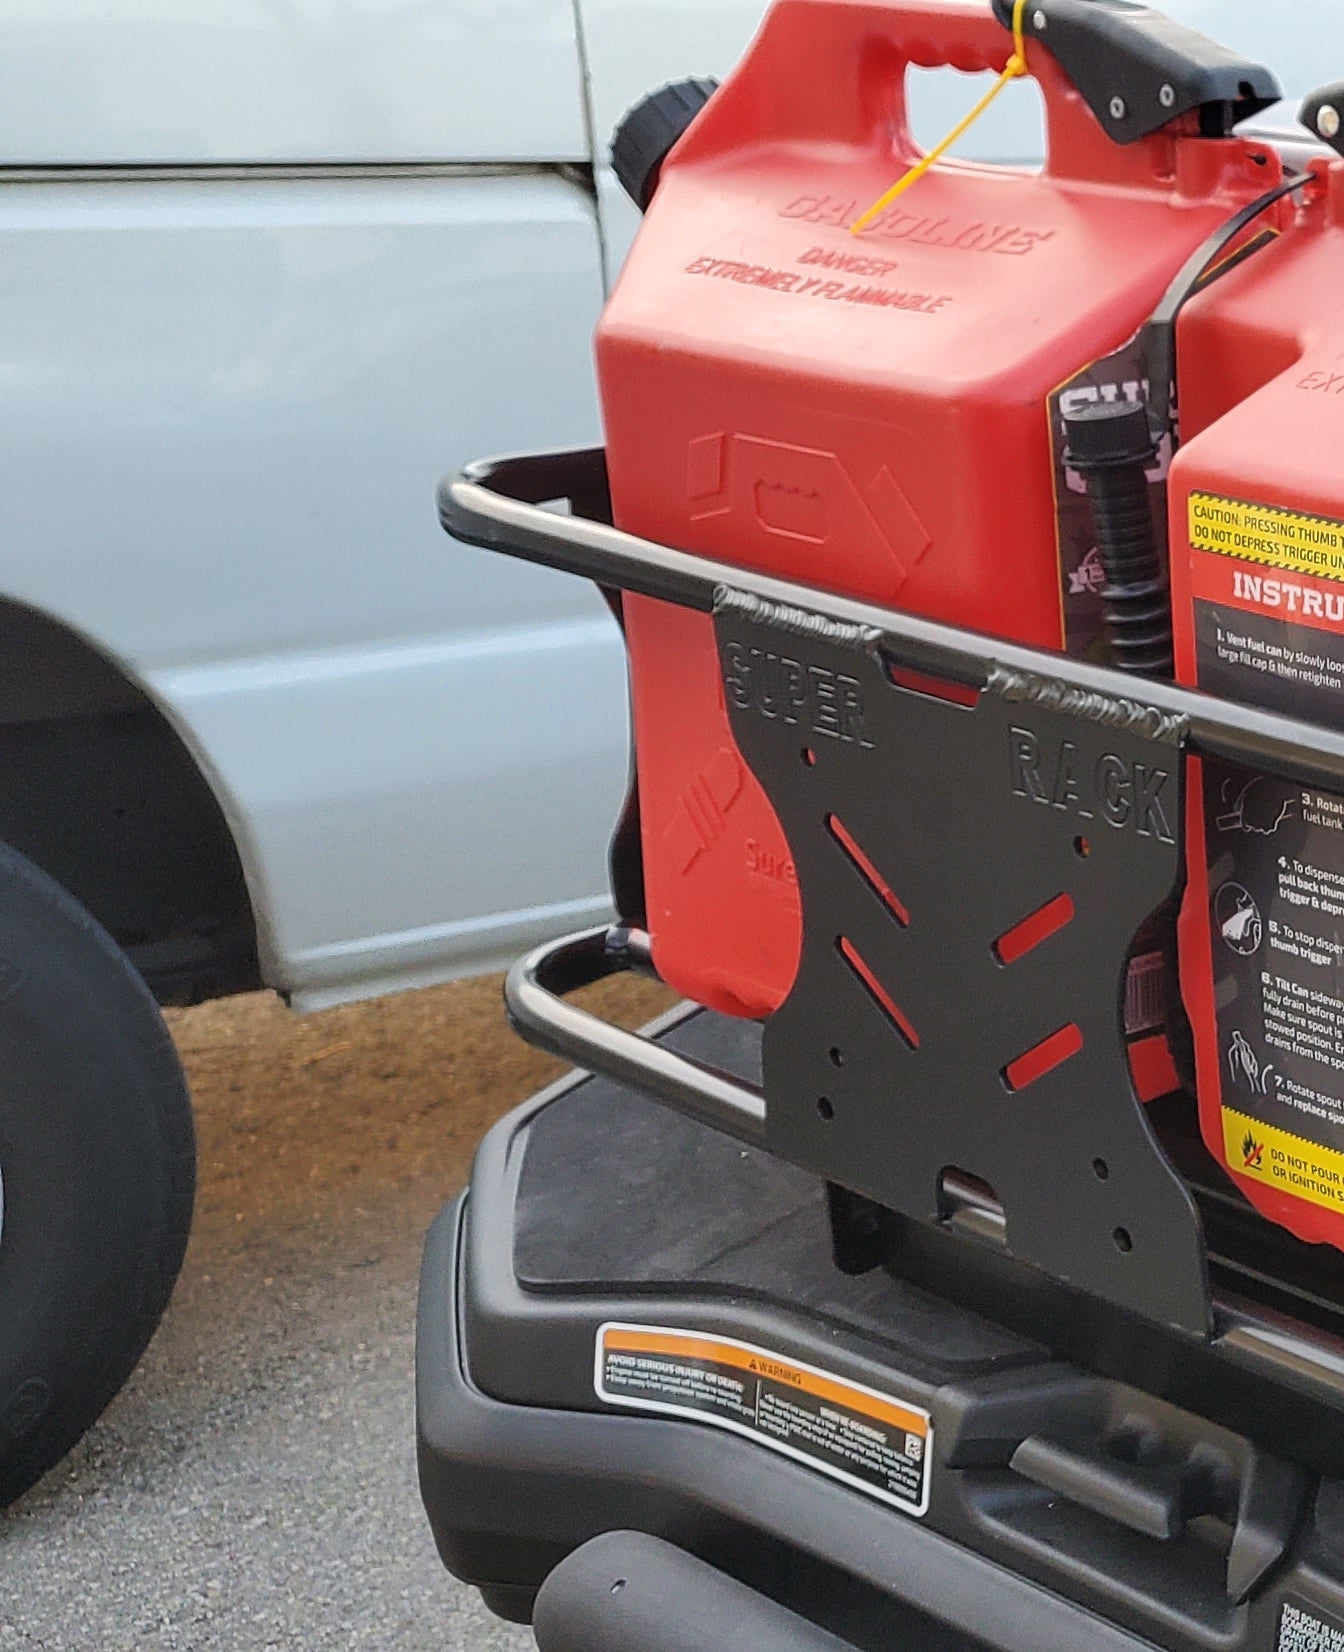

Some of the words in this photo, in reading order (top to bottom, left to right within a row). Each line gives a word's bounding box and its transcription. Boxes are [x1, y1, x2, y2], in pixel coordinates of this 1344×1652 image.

[796, 247, 898, 277] DANGER
[684, 255, 822, 294] EXTREMELY
[810, 281, 955, 314] FLAMMABLE
[1193, 505, 1242, 526] CAUTION:
[1244, 517, 1295, 538] PRESSING
[1298, 527, 1337, 547] THUMB
[1195, 525, 1208, 539] DO
[1211, 529, 1232, 544] NOT
[1234, 535, 1280, 555] DEPRESS
[1283, 545, 1327, 566] TRIGGER
[1226, 631, 1247, 648] Vent
[1247, 635, 1265, 652] fuel
[1265, 642, 1283, 657] can
[1283, 644, 1294, 663] by
[1295, 650, 1325, 670] slowly
[1218, 647, 1238, 668] large
[1239, 650, 1251, 666] fill
[1252, 655, 1267, 672] cap
[1268, 659, 1276, 672] &
[1277, 661, 1298, 679] then
[1299, 667, 1341, 689] retighten
[726, 641, 876, 749] SUPER
[1010, 725, 1175, 846] RACK
[1301, 793, 1314, 807] 3.
[1303, 809, 1322, 823] fuel
[1322, 815, 1343, 831] tank
[1278, 856, 1291, 870] 4.
[1292, 859, 1303, 873] To
[1278, 873, 1296, 887] pull
[1297, 877, 1319, 893] back
[1279, 887, 1310, 908] trigger
[1311, 897, 1320, 909] &
[1270, 936, 1300, 956] thumb
[1300, 946, 1332, 966] trigger
[1283, 924, 1294, 939] To
[1295, 929, 1315, 947] stop
[1275, 977, 1291, 992] Tilt
[1292, 983, 1309, 998] Can
[1262, 988, 1282, 1005] fully
[1282, 995, 1305, 1013] drain
[1306, 1002, 1335, 1022] before
[1263, 1002, 1287, 1020] Make
[1287, 1012, 1307, 1027] sure
[1308, 1017, 1333, 1037] spout
[1334, 1026, 1343, 1039] is
[1264, 1018, 1295, 1037] stowed
[1296, 1030, 1334, 1052] position.
[1265, 1032, 1291, 1052] drains
[1292, 1043, 1314, 1060] from
[1314, 1050, 1330, 1065] the
[1274, 1074, 1285, 1089] 7.
[1286, 1079, 1316, 1101] Rotate
[1316, 1091, 1343, 1112] spout
[1276, 1091, 1292, 1106] and
[1293, 1098, 1327, 1122] replace
[1271, 1148, 1285, 1163] DO
[1287, 1156, 1309, 1172] NOT
[1311, 1165, 1341, 1184] POUR
[1273, 1165, 1288, 1180] OR
[1290, 1172, 1335, 1199] IGNITION
[760, 1362, 801, 1384] WARNING
